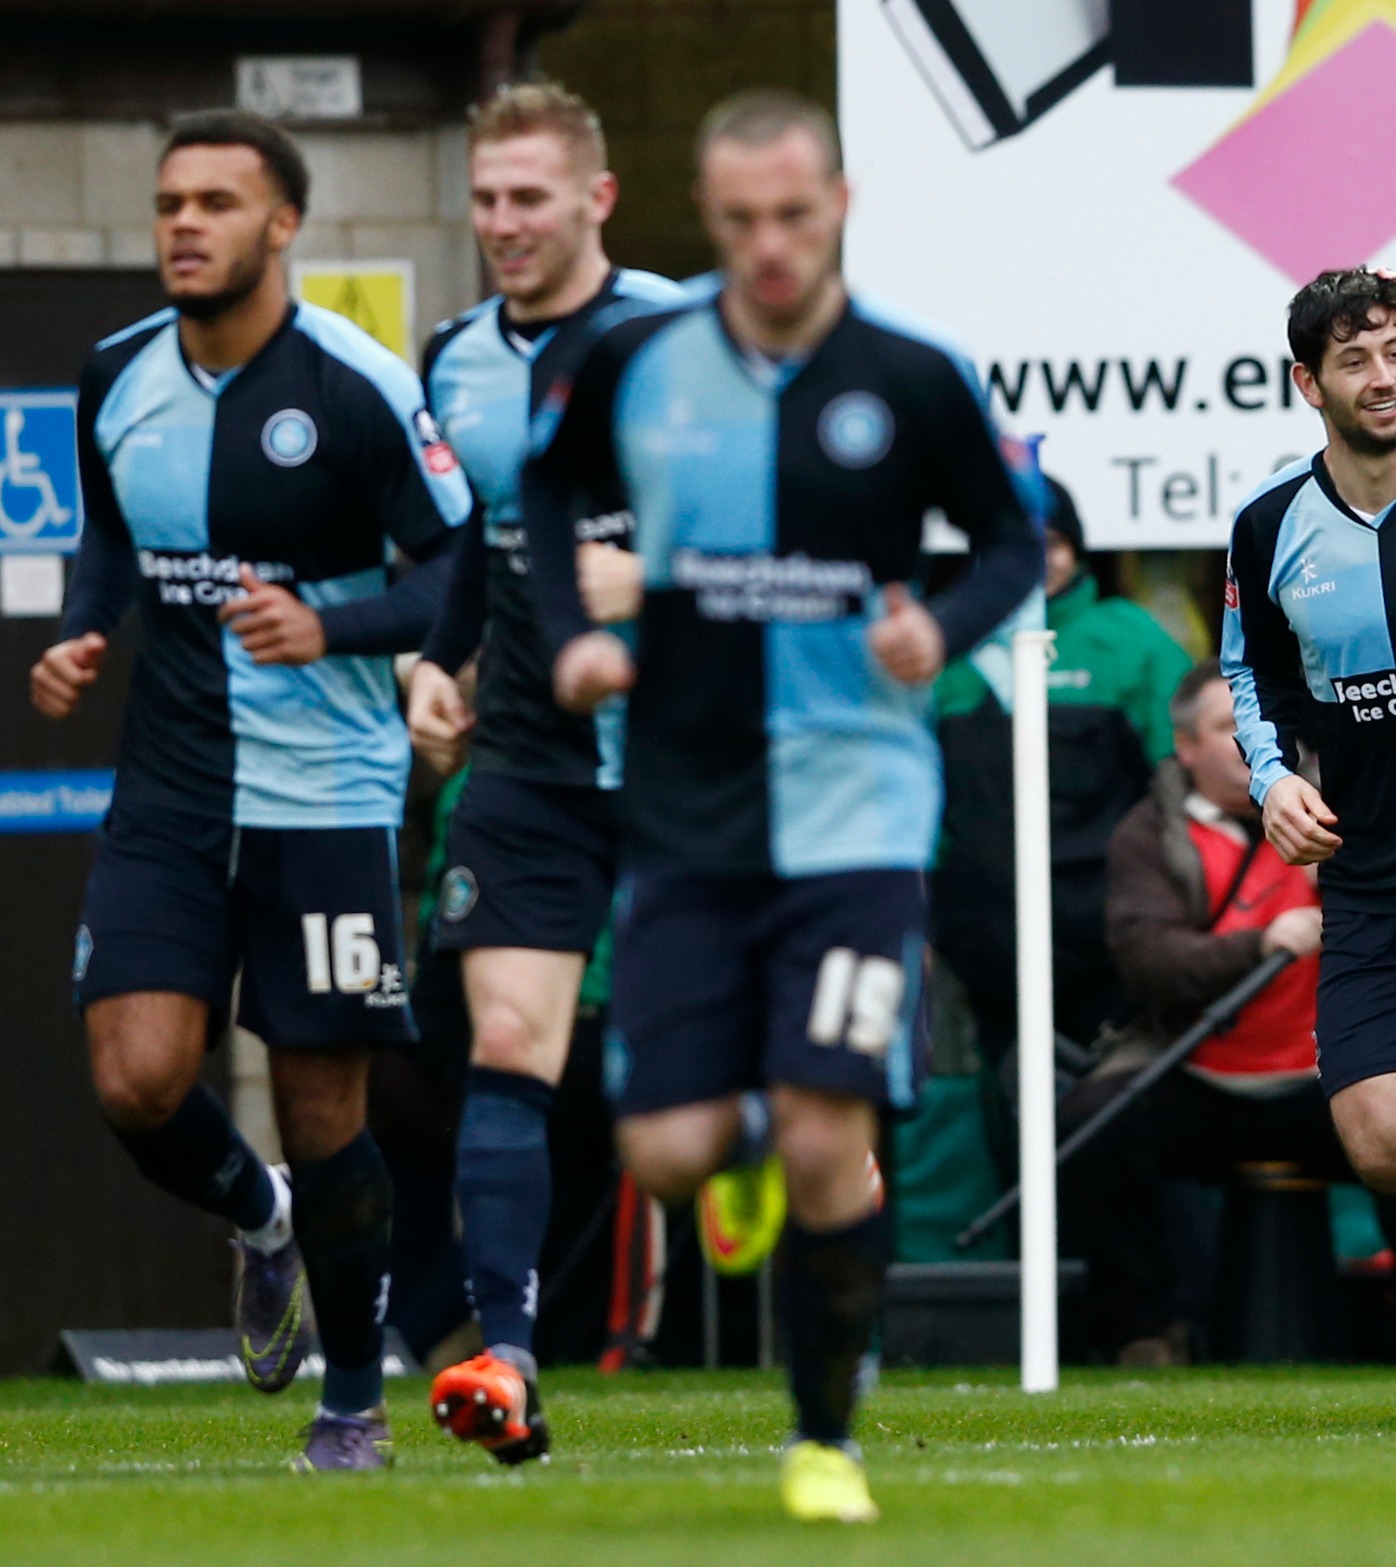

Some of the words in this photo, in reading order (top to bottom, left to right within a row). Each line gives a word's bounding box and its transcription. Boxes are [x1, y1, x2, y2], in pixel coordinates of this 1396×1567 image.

[138, 551, 296, 583] Beechdan
[1292, 580, 1336, 600] KUKRI
[1352, 705, 1384, 722] Ice
[301, 911, 381, 994] 16
